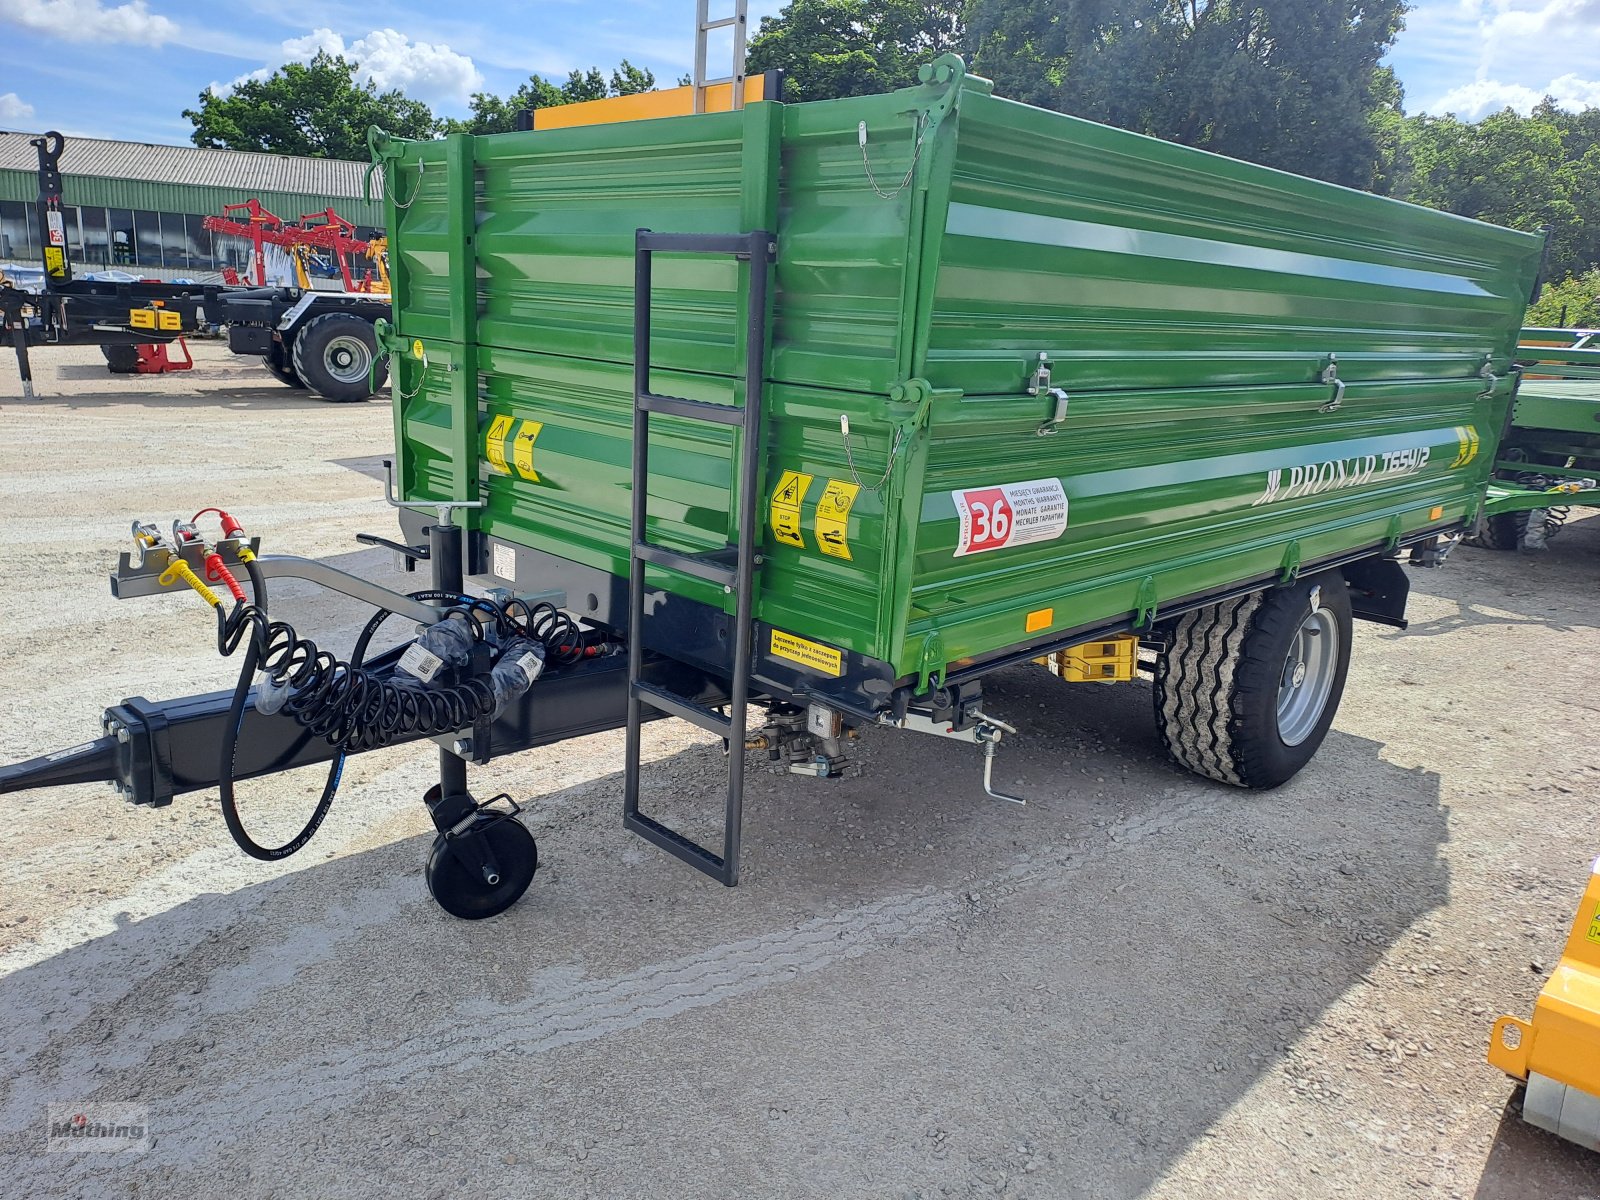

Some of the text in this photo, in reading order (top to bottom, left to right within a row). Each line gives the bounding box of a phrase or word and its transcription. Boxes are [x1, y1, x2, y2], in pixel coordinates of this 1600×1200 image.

[1282, 446, 1431, 499] PRONAR T654/2
[1013, 494, 1062, 507] MONTHS WARRANTY
[1016, 503, 1065, 517] MONATE GARANTIE
[959, 502, 970, 542] PRONAR
[970, 499, 1009, 543] 36
